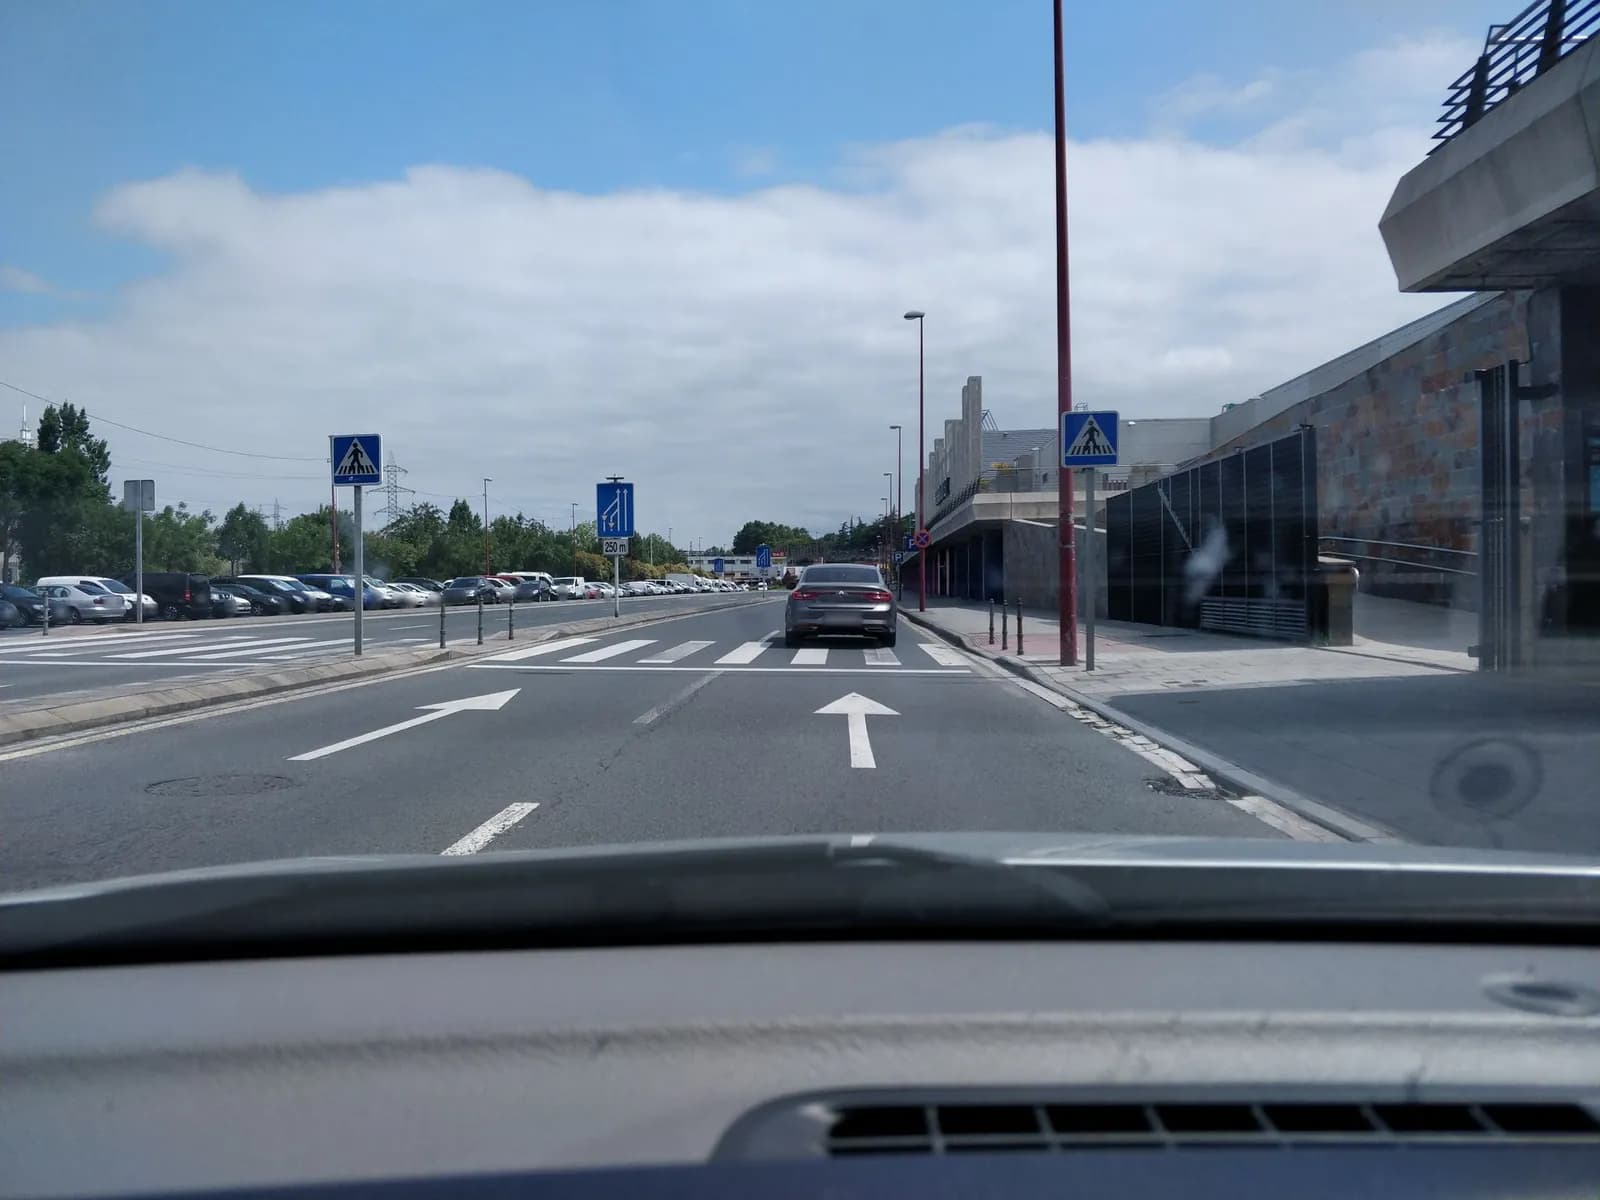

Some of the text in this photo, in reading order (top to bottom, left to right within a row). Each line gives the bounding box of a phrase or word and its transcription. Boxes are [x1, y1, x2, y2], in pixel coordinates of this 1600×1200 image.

[605, 541, 626, 553] 250 m
[895, 553, 902, 562] P
